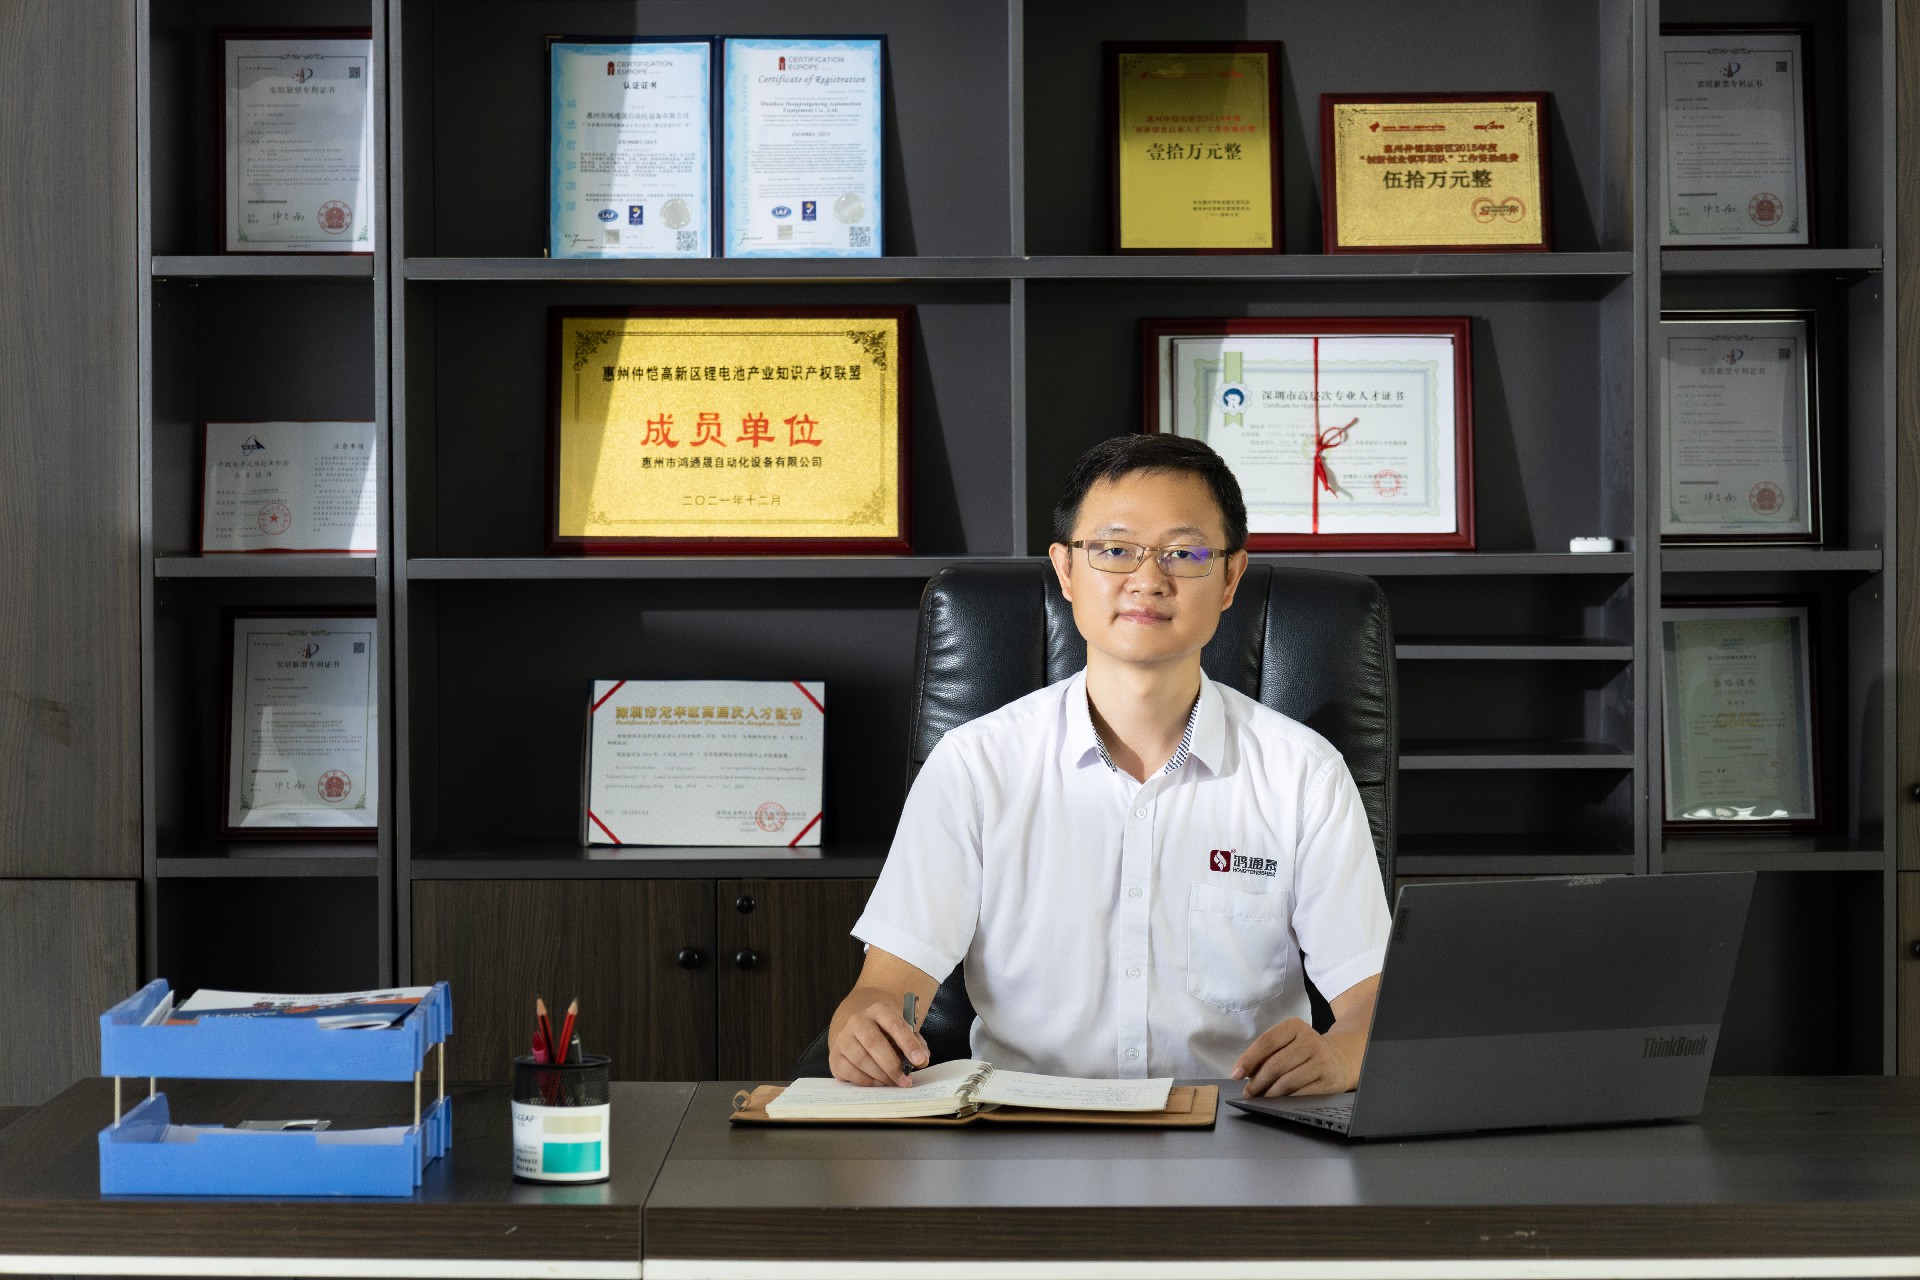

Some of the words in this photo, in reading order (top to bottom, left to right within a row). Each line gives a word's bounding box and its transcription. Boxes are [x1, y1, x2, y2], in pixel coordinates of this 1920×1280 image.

[623, 81, 657, 90] 认证证书
[758, 74, 802, 85] Certificate
[803, 74, 815, 86] of
[815, 75, 866, 86] Registration
[1146, 142, 1242, 160] 壹拾万元整
[1383, 169, 1493, 189] 伍拾万元整
[602, 365, 862, 382] 惠州仲恺高新区锂电池产业知识产权联盟
[640, 411, 824, 449] 成员单位
[641, 455, 823, 469] 惠州市鸿通晟自动化设备有限公司
[1642, 1034, 1709, 1059] ThinkBook
